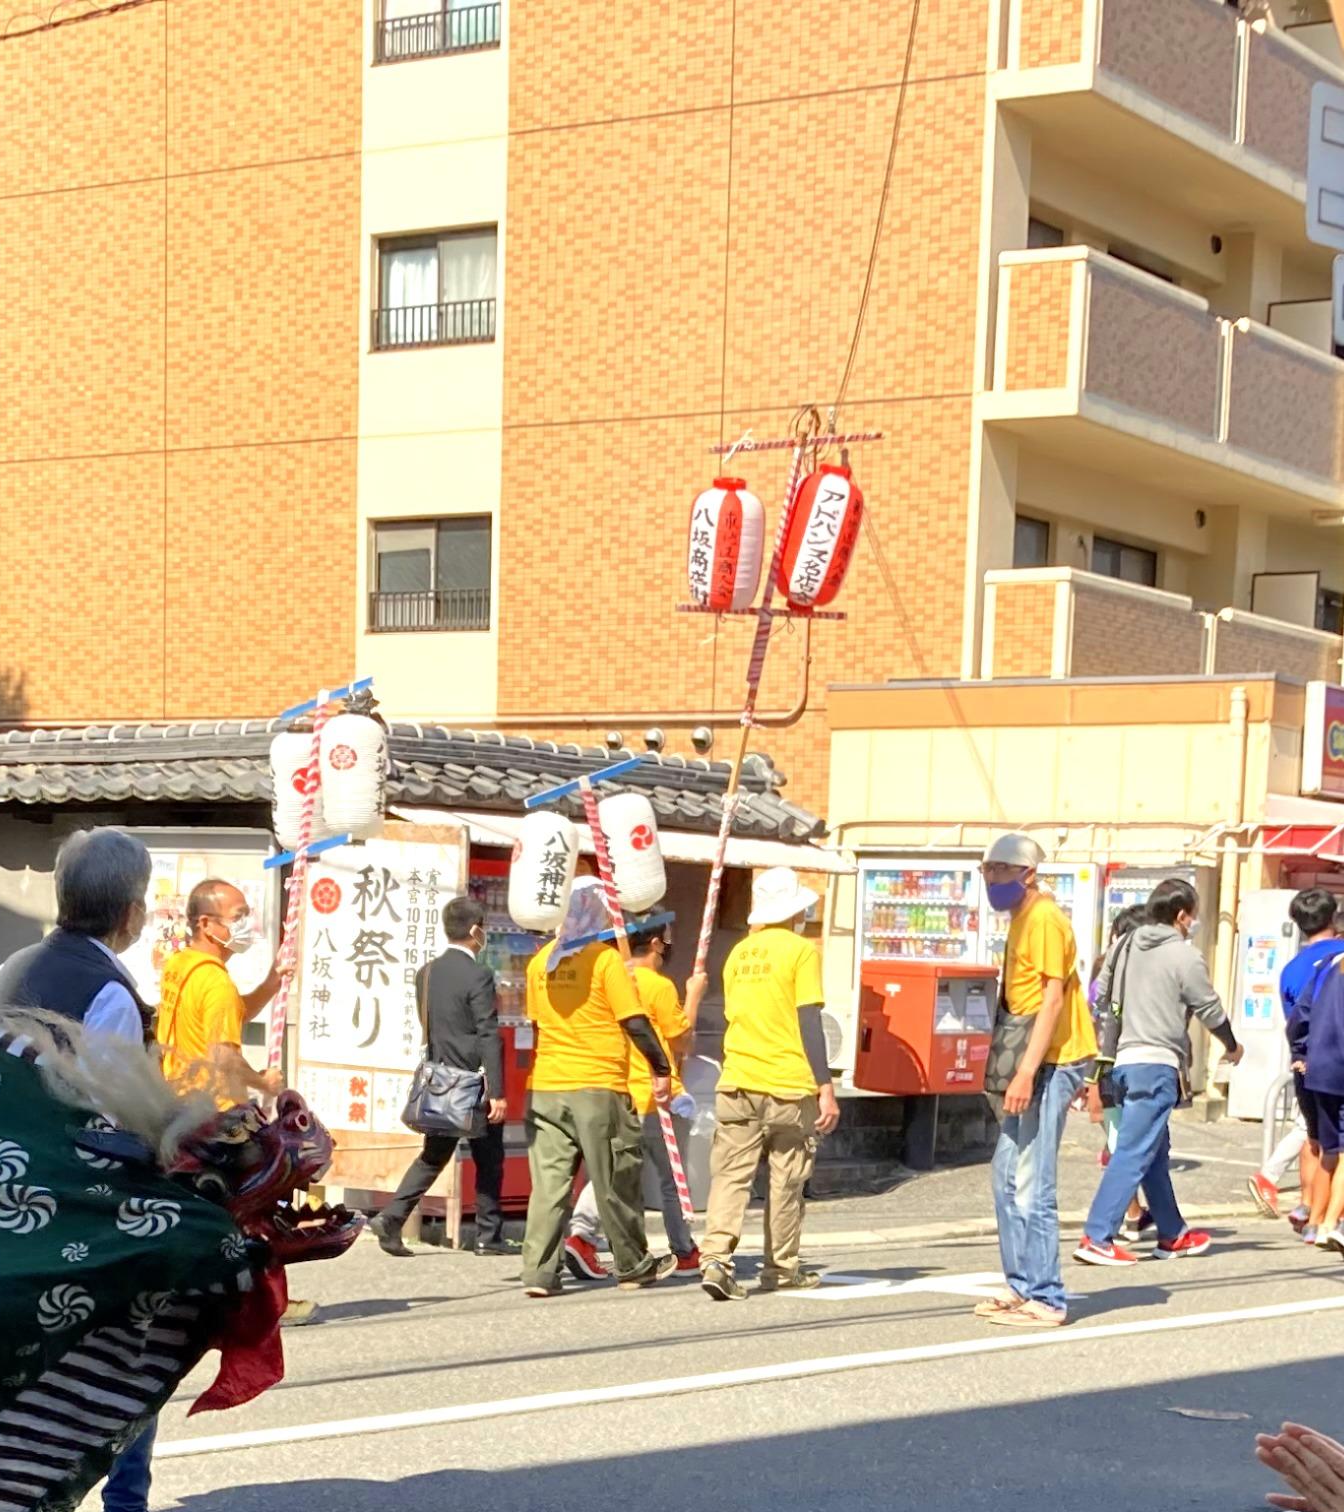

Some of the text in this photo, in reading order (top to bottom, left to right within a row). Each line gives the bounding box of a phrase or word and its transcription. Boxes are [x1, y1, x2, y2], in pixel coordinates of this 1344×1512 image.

[536, 830, 570, 908] 八坂神社
[308, 927, 339, 1041] 八坂神社
[344, 864, 402, 1049] 秋祭り
